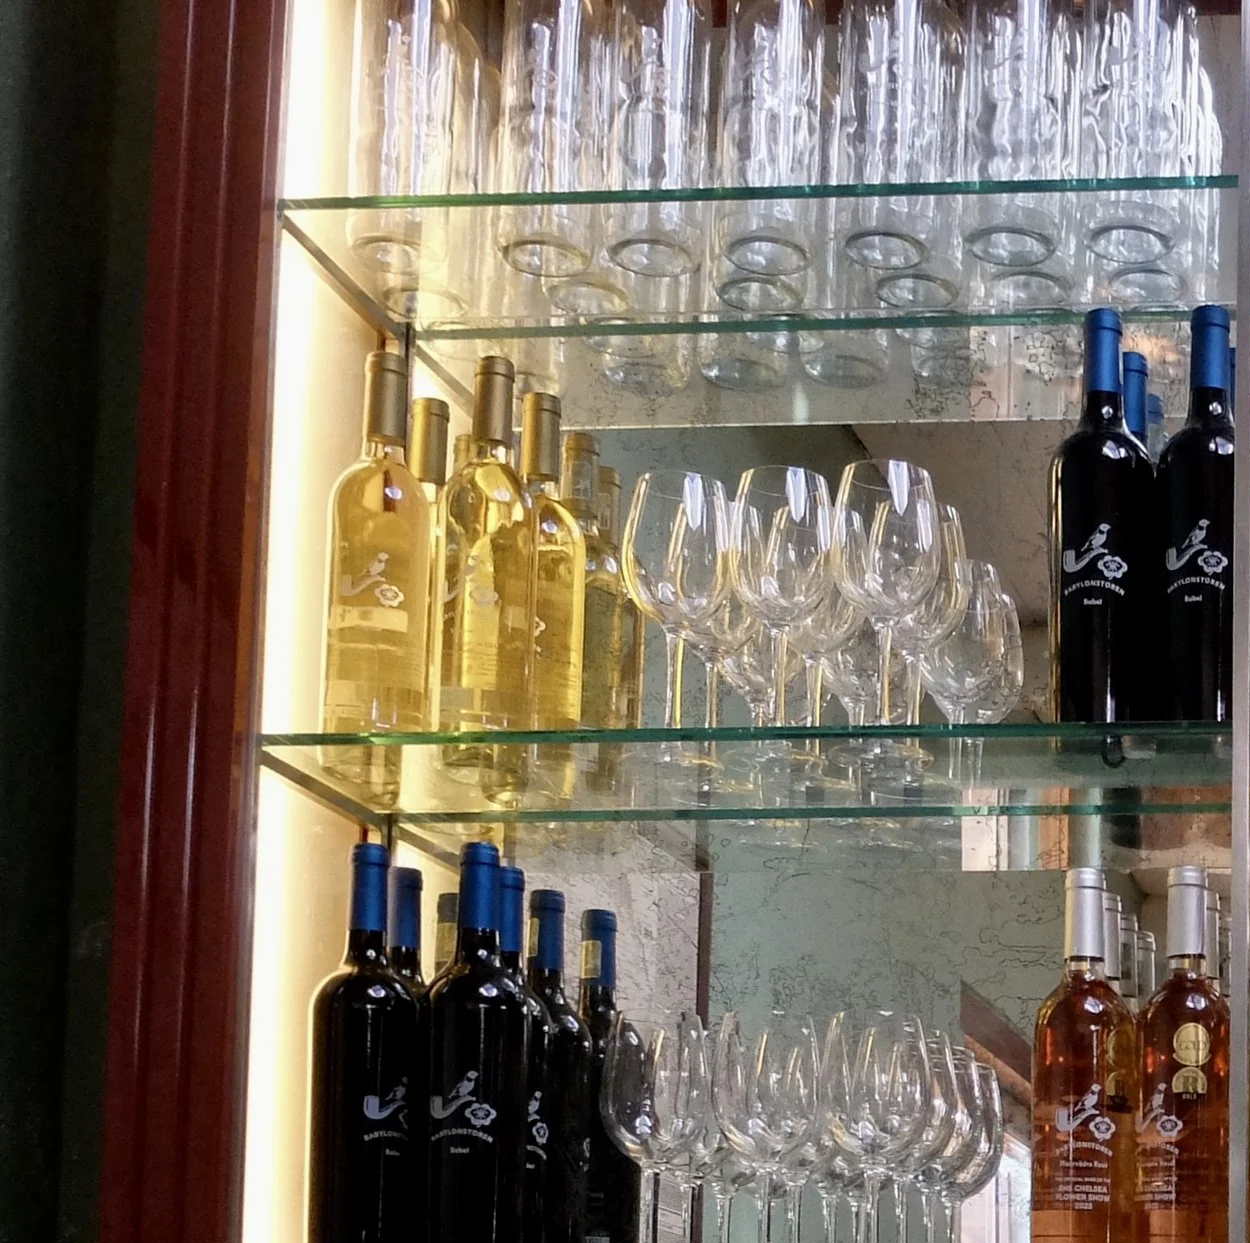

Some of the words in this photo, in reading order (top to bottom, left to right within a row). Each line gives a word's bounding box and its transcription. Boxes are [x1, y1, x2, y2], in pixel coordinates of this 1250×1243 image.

[1064, 580, 1125, 596] BABYLONSTOREN
[1074, 1184, 1107, 1193] CHELSEA
[1088, 1193, 1110, 1202] SHOW
